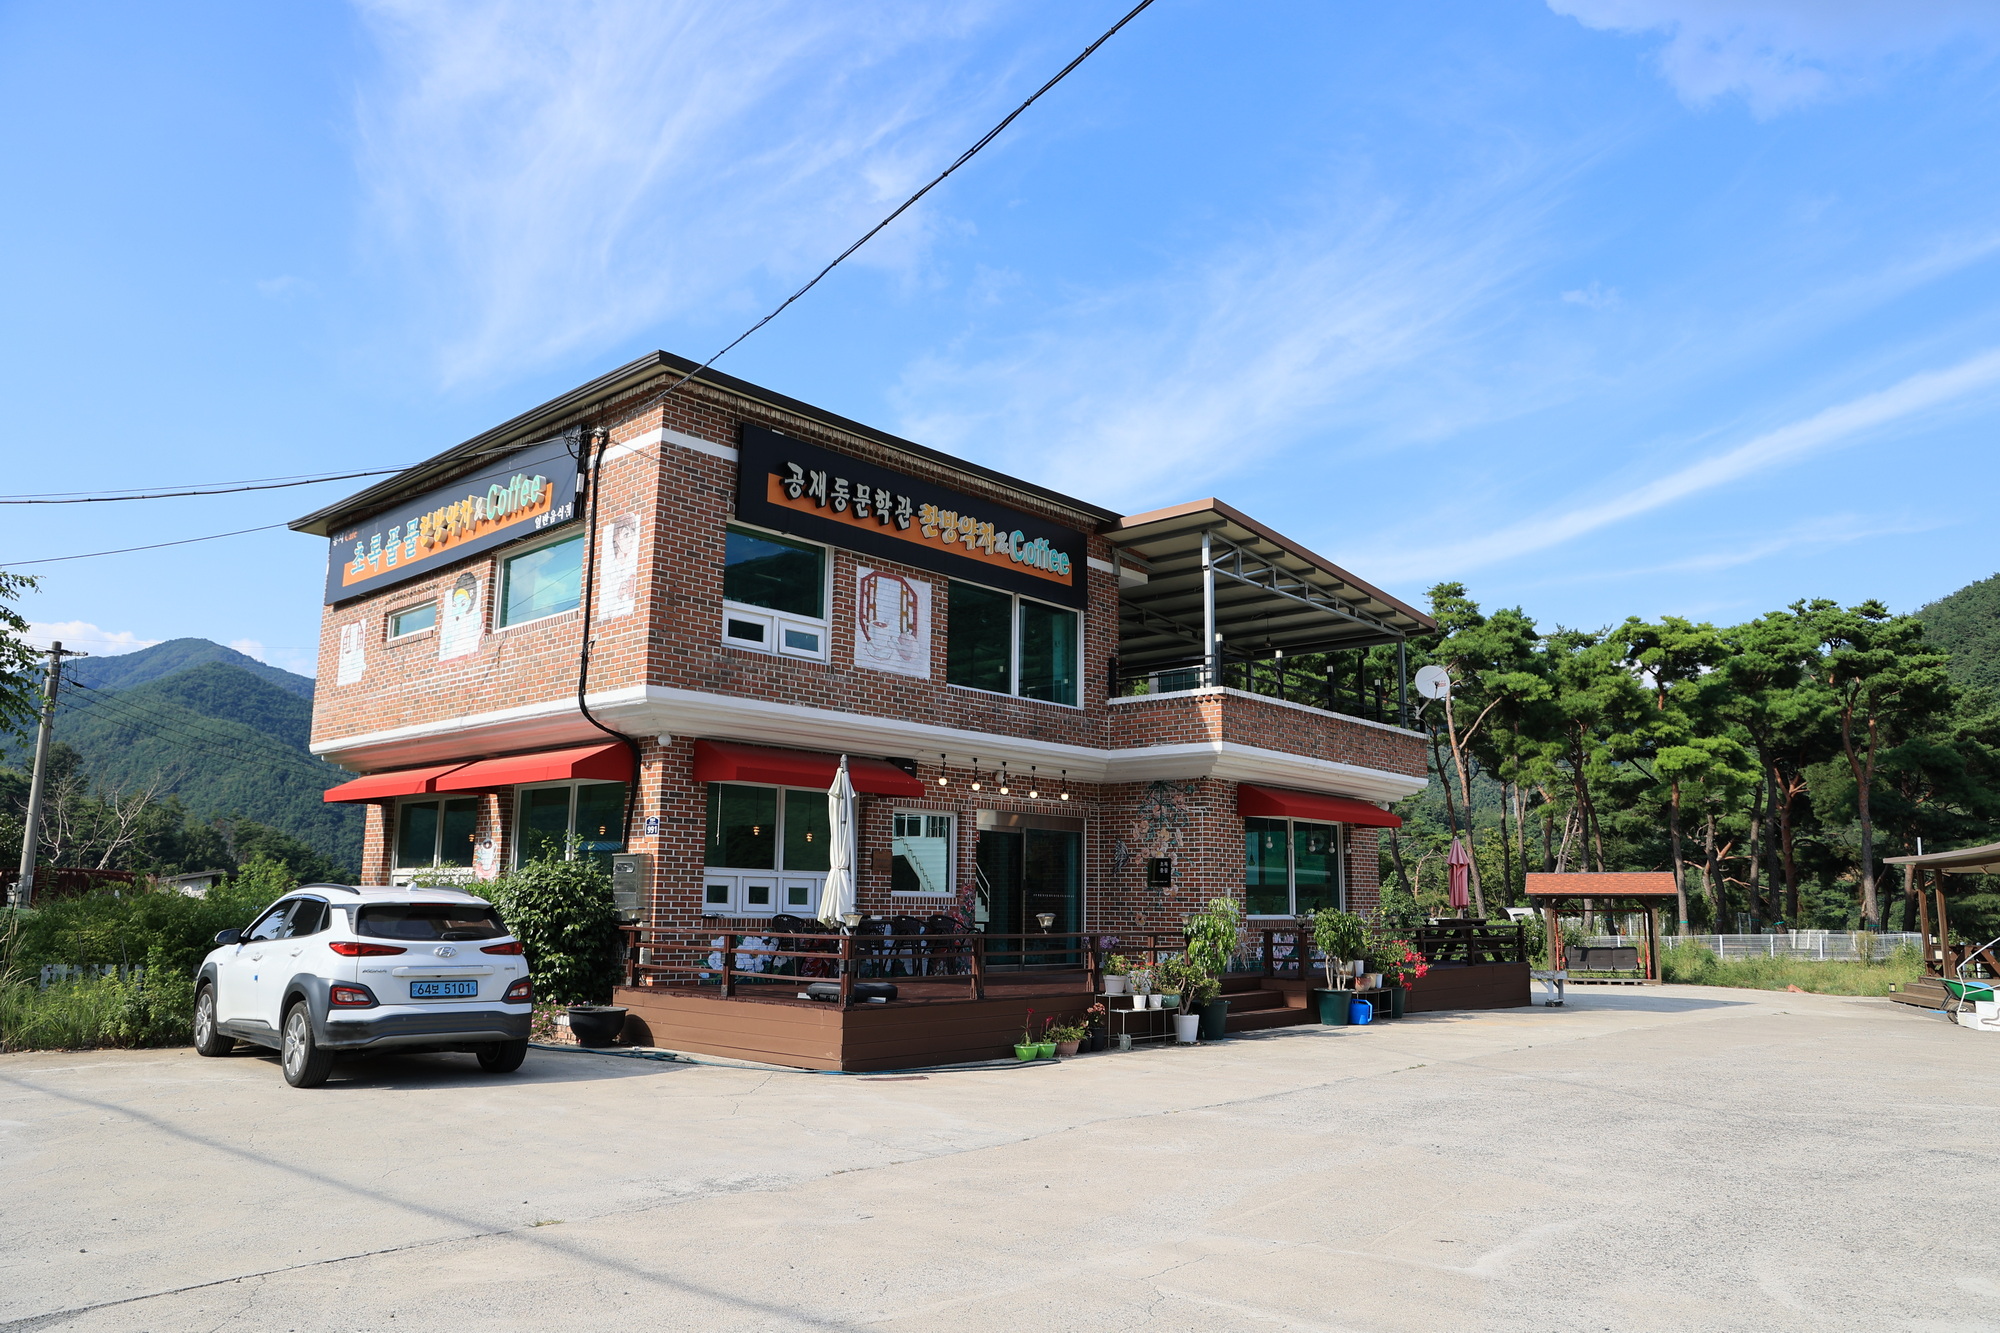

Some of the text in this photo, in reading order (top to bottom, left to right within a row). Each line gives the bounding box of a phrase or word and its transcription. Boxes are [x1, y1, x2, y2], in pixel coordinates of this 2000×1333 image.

[784, 461, 913, 530] 공재동문학관
[646, 825, 658, 834] 991
[417, 983, 470, 995] 64보 5101
